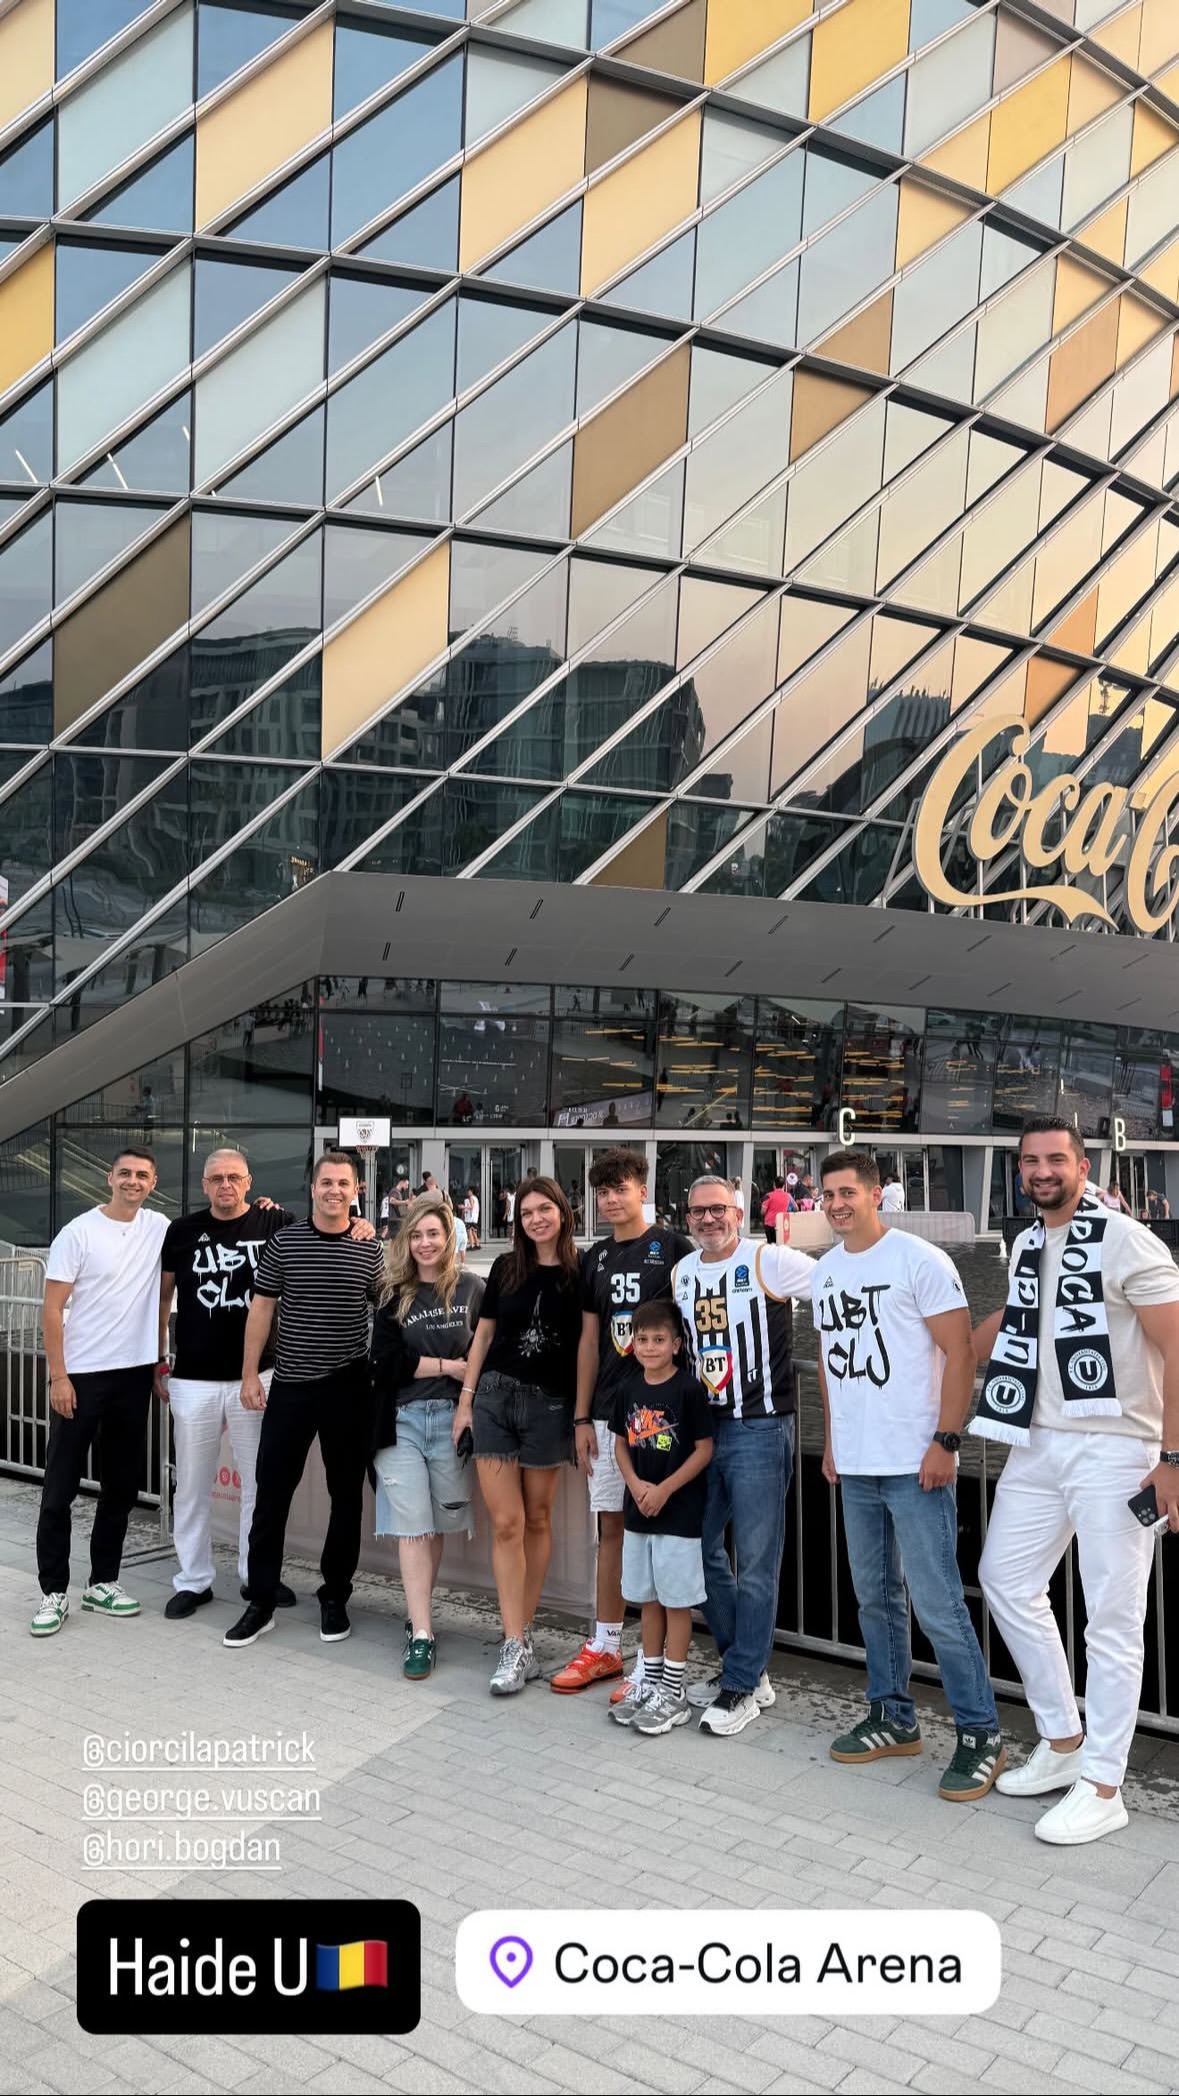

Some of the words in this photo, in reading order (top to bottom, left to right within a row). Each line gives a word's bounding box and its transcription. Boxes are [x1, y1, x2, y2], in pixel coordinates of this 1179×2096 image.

[913, 713, 1179, 933] Coca-C
[838, 1107, 857, 1146] C
[1114, 1117, 1126, 1152] B
[192, 1240, 266, 1274] UBT
[610, 1272, 641, 1304] 35
[695, 1297, 728, 1332] 35
[819, 1284, 891, 1332] UBT
[705, 1357, 726, 1374] BT
[828, 1327, 890, 1387] CLJ
[1078, 1360, 1098, 1381] U
[996, 1384, 1017, 1405] U
